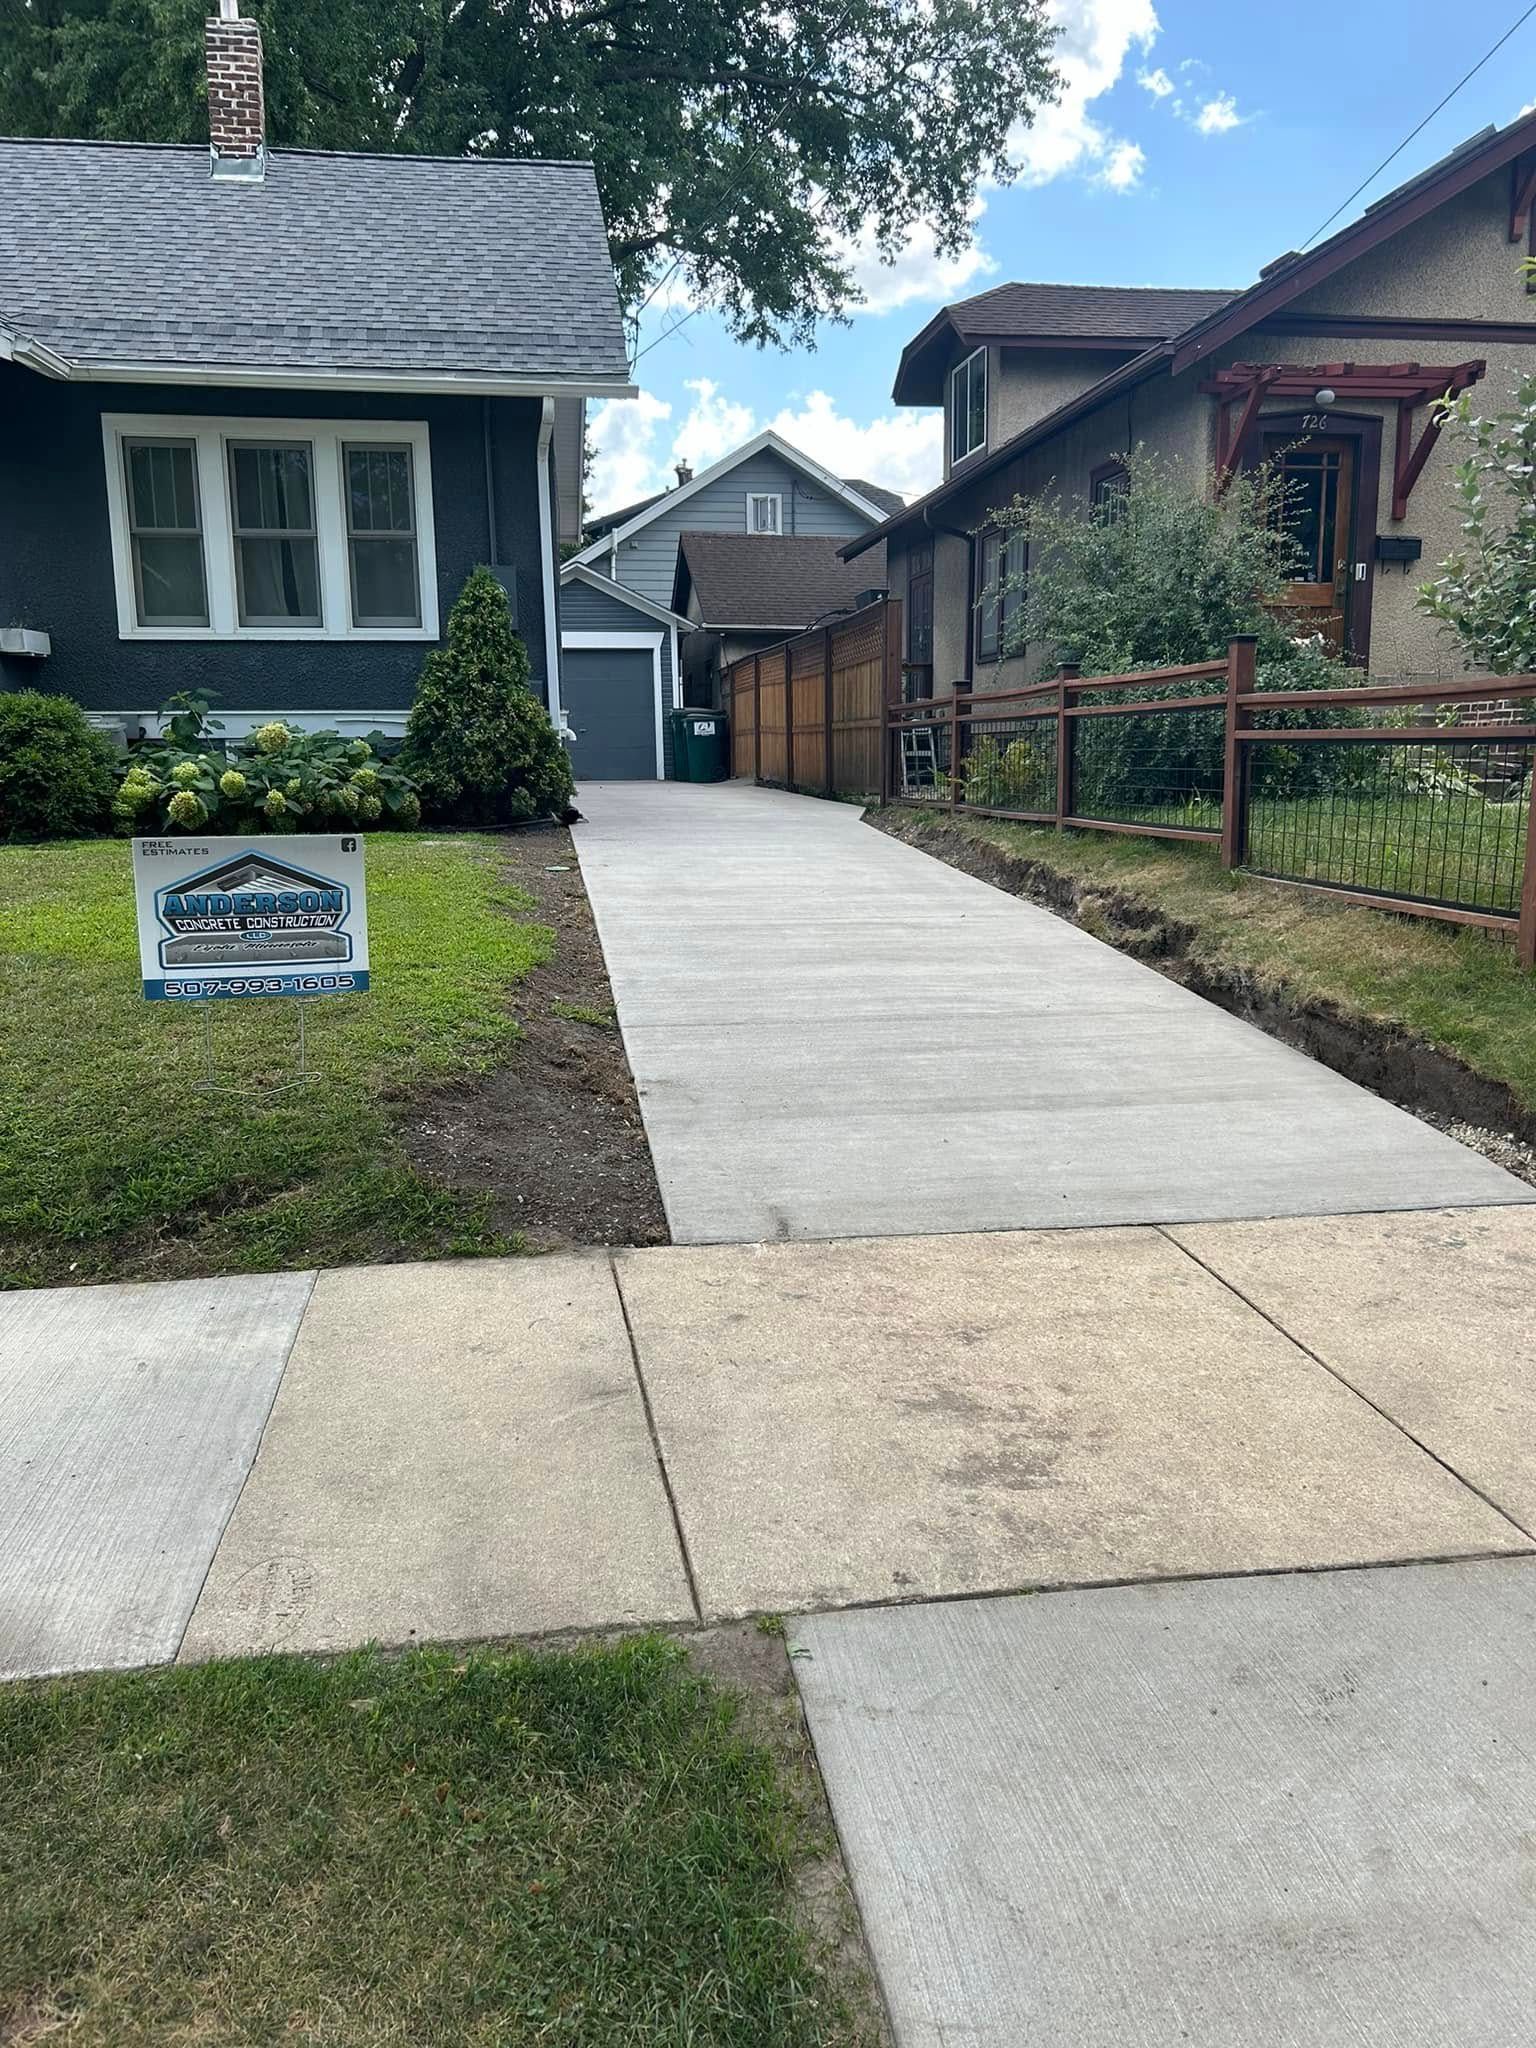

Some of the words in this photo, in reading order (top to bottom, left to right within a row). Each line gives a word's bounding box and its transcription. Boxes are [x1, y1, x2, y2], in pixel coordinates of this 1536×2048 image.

[1302, 414, 1328, 430] 726
[142, 848, 209, 856] ESTIMATES
[162, 890, 343, 917] ANDERSON
[175, 917, 241, 931] CONCRETE
[246, 915, 336, 929] CONSTRUCTION
[165, 975, 354, 996] 507-993-1605
